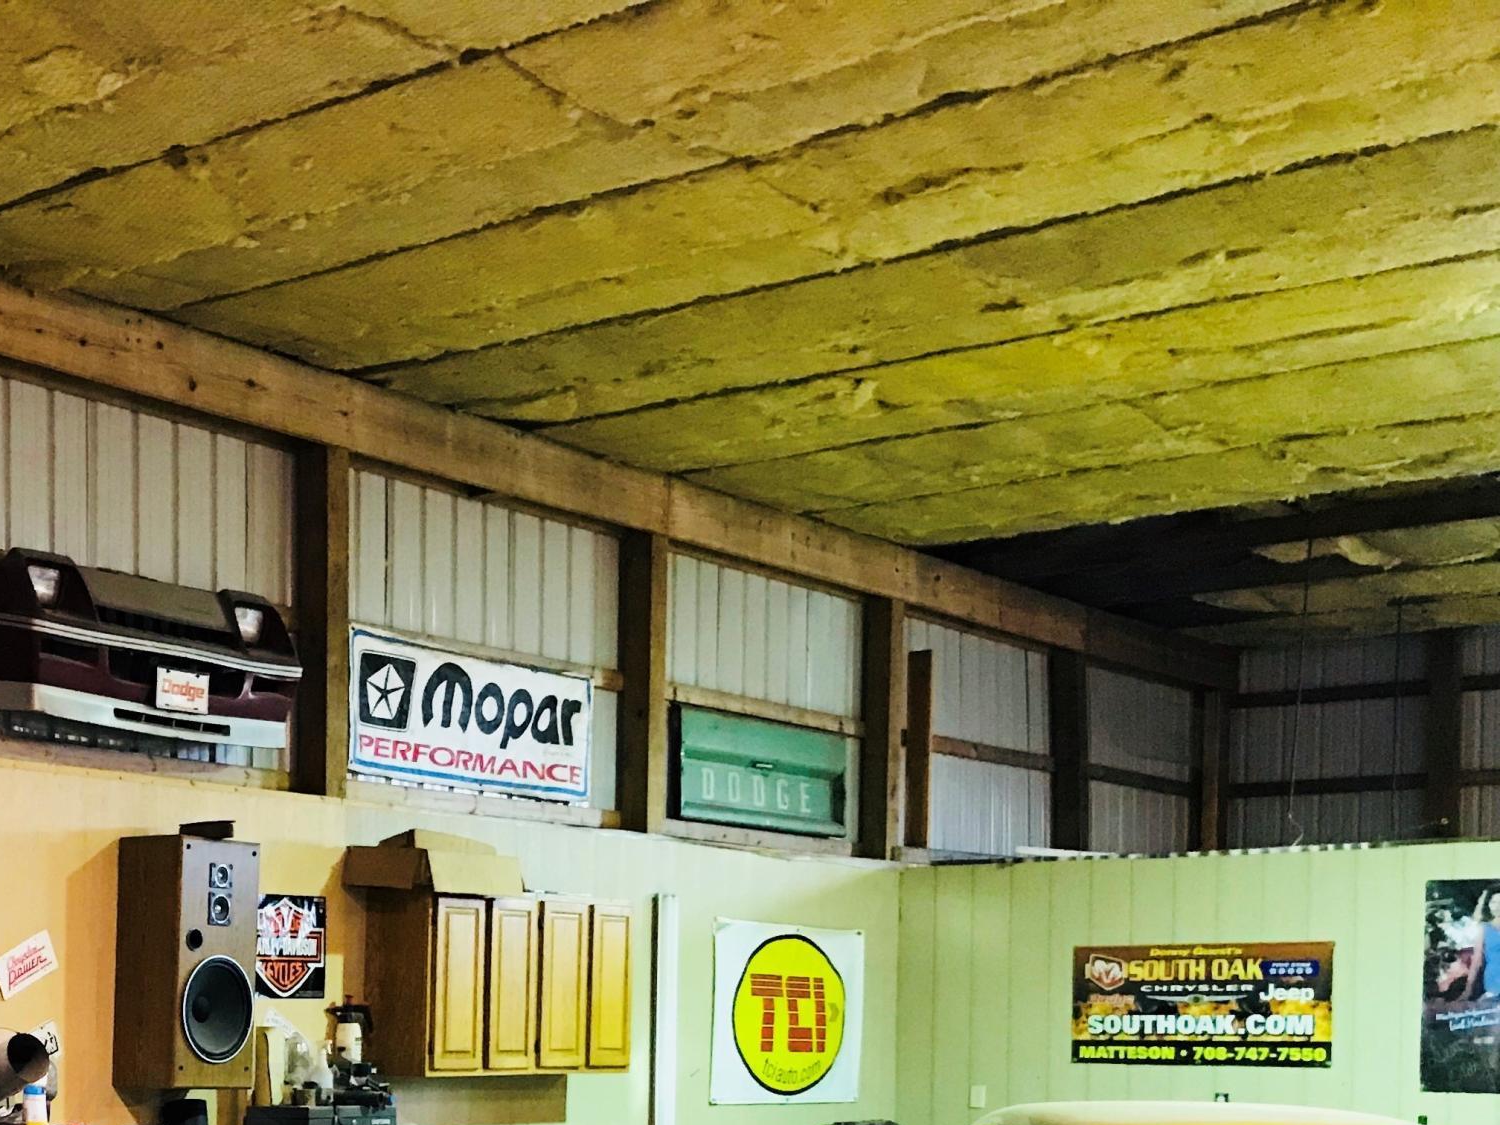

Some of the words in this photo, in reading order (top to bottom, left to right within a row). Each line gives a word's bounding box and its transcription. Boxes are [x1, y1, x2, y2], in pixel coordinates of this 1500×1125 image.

[161, 679, 206, 701] Dodge
[359, 733, 582, 785] PERFORMANCE
[702, 767, 812, 813] DODGE
[1128, 958, 1205, 981] SOUTH
[1211, 958, 1264, 981] OAK
[1140, 984, 1254, 993] CHRYSLER
[1259, 983, 1315, 1003] Jeep
[750, 973, 827, 1053] TCI
[1087, 1013, 1315, 1036] SOUTHOAK.COM
[1078, 1045, 1175, 1060] MATTESON
